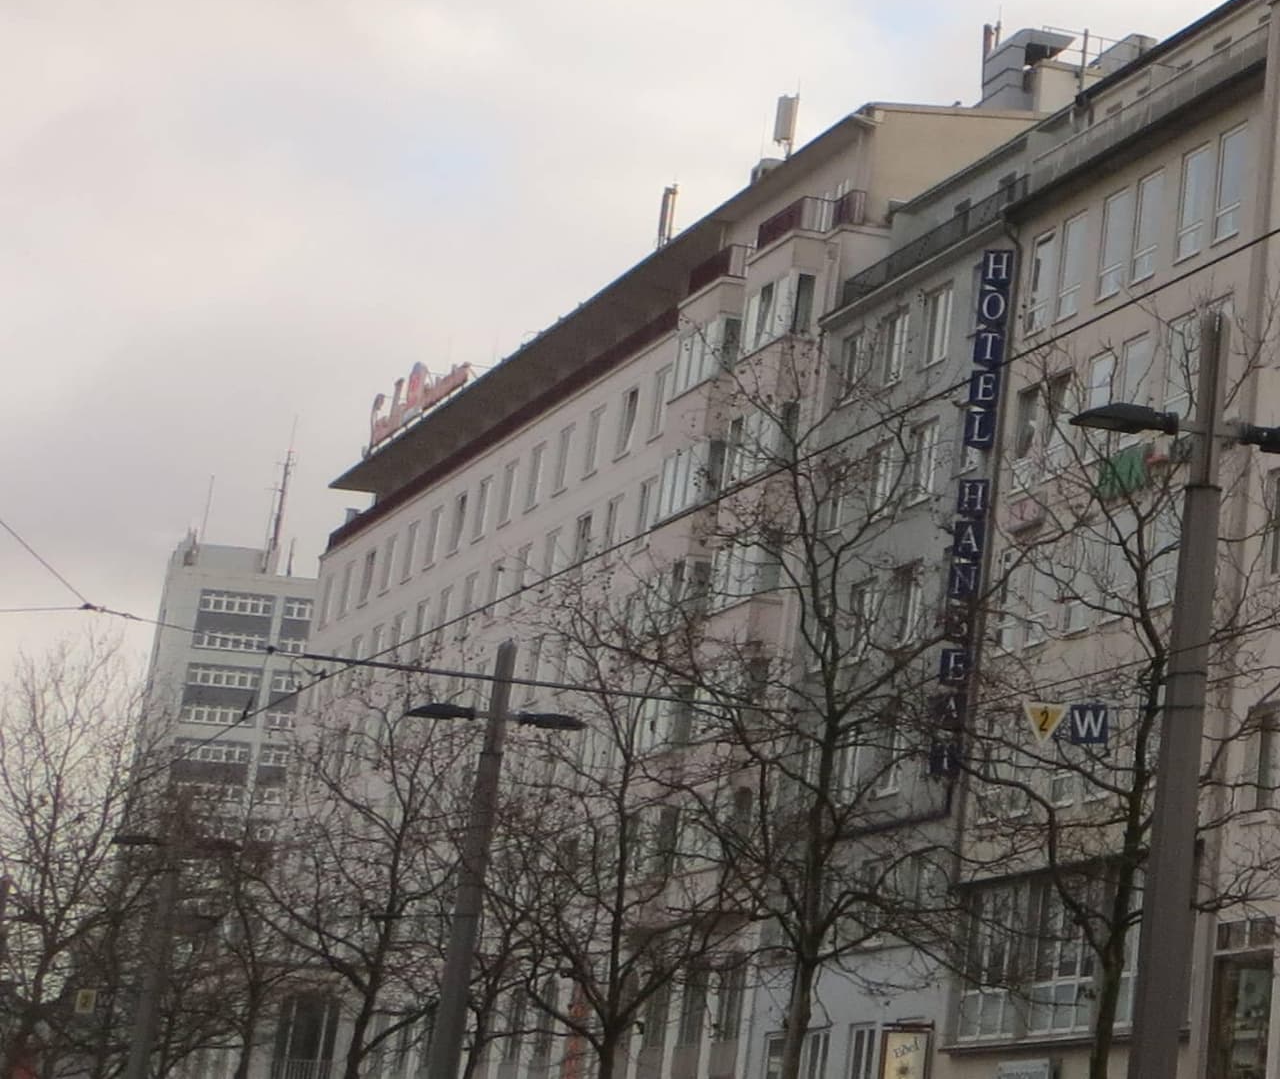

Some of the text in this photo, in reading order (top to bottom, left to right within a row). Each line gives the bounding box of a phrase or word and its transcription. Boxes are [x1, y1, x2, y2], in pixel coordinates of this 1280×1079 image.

[970, 252, 1009, 442] HOTEL
[1039, 706, 1050, 732] 2
[1075, 709, 1106, 738] W
